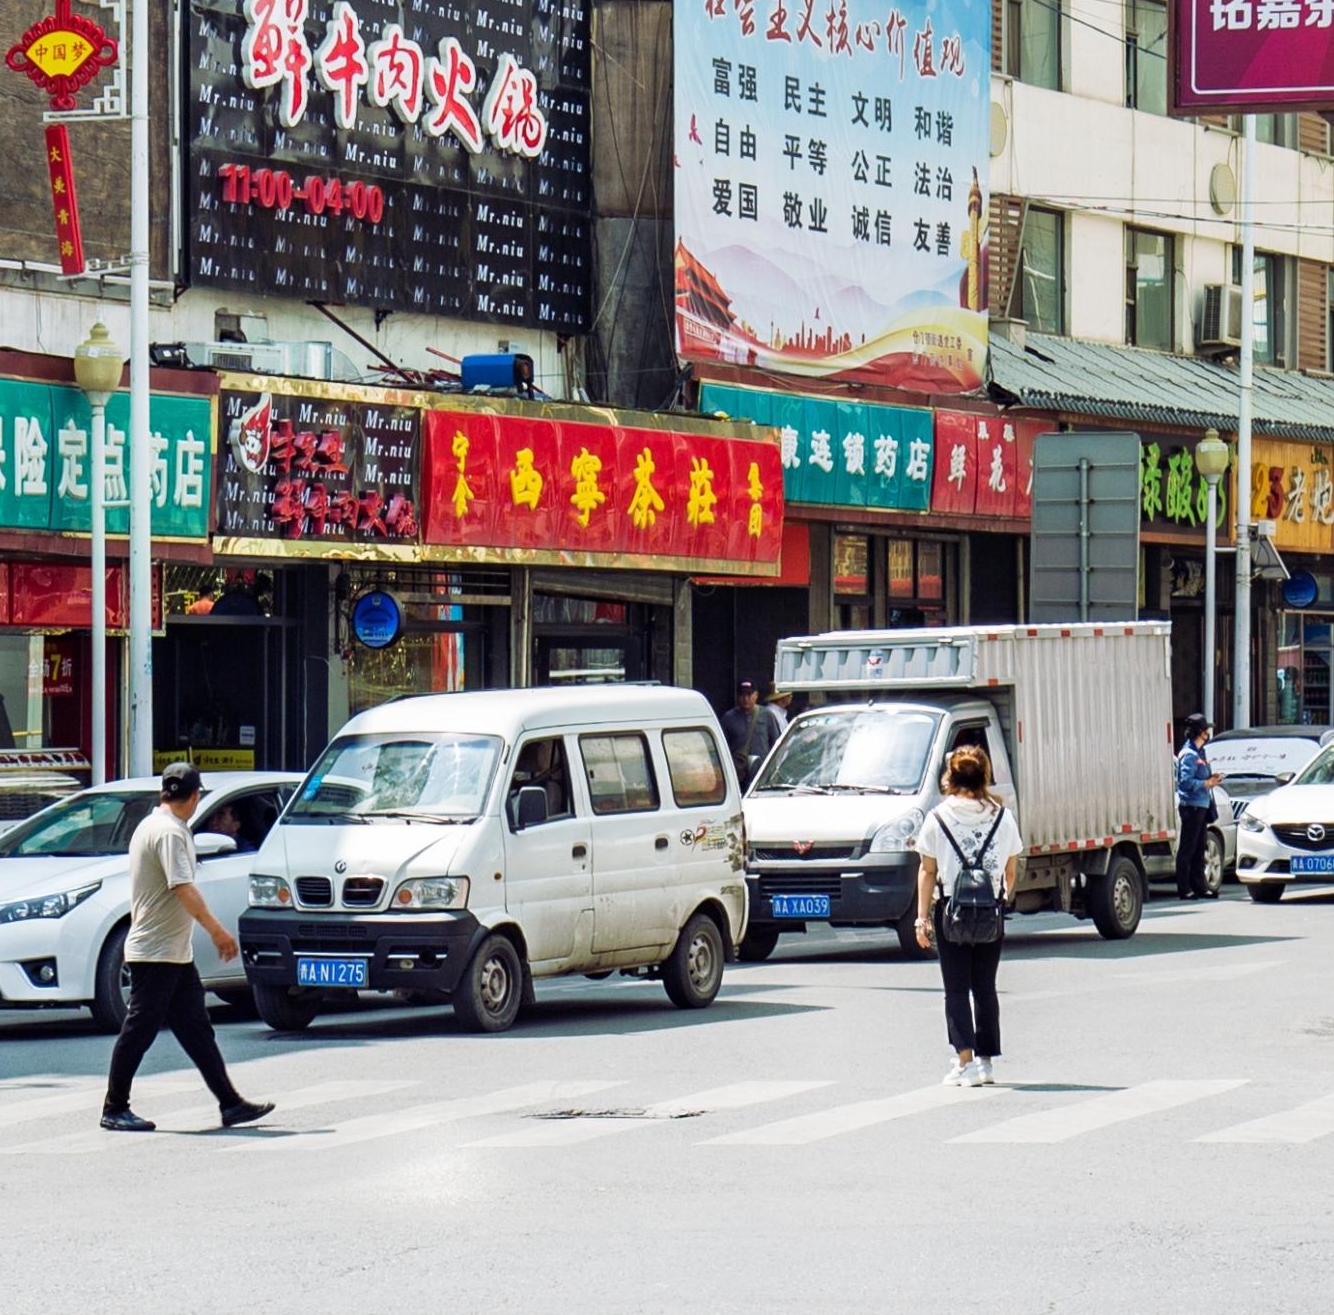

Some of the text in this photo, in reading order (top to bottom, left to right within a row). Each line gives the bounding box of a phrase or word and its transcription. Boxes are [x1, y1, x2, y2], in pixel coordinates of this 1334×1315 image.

[478, 9, 524, 36] Mr.niu
[538, 27, 583, 51] Mr.niu
[35, 41, 89, 63] 中国梦
[199, 84, 255, 110] Mr.niu
[538, 92, 583, 115] Mr.niu
[712, 58, 954, 147] 富强 民主 文明 和谐
[345, 143, 396, 168] Mr.niu
[713, 119, 954, 202] 自由 平等 公正 法治
[50, 146, 74, 257] 大美青海
[219, 163, 384, 224] 11:00-04:00
[478, 206, 524, 228] Mr.niu
[712, 179, 952, 257] 爱国 敬业 诚信 友善
[478, 235, 524, 257] Mr.niu
[478, 265, 524, 286] Mr.niu
[478, 296, 524, 317] Mr.niu
[299, 404, 347, 426] Mr.niu
[365, 410, 412, 431] Mr.niu
[365, 437, 411, 458] Mr.niu
[365, 464, 411, 485] Mr.niu
[226, 482, 276, 504] Mr.niu
[226, 511, 274, 531] Mr.niu
